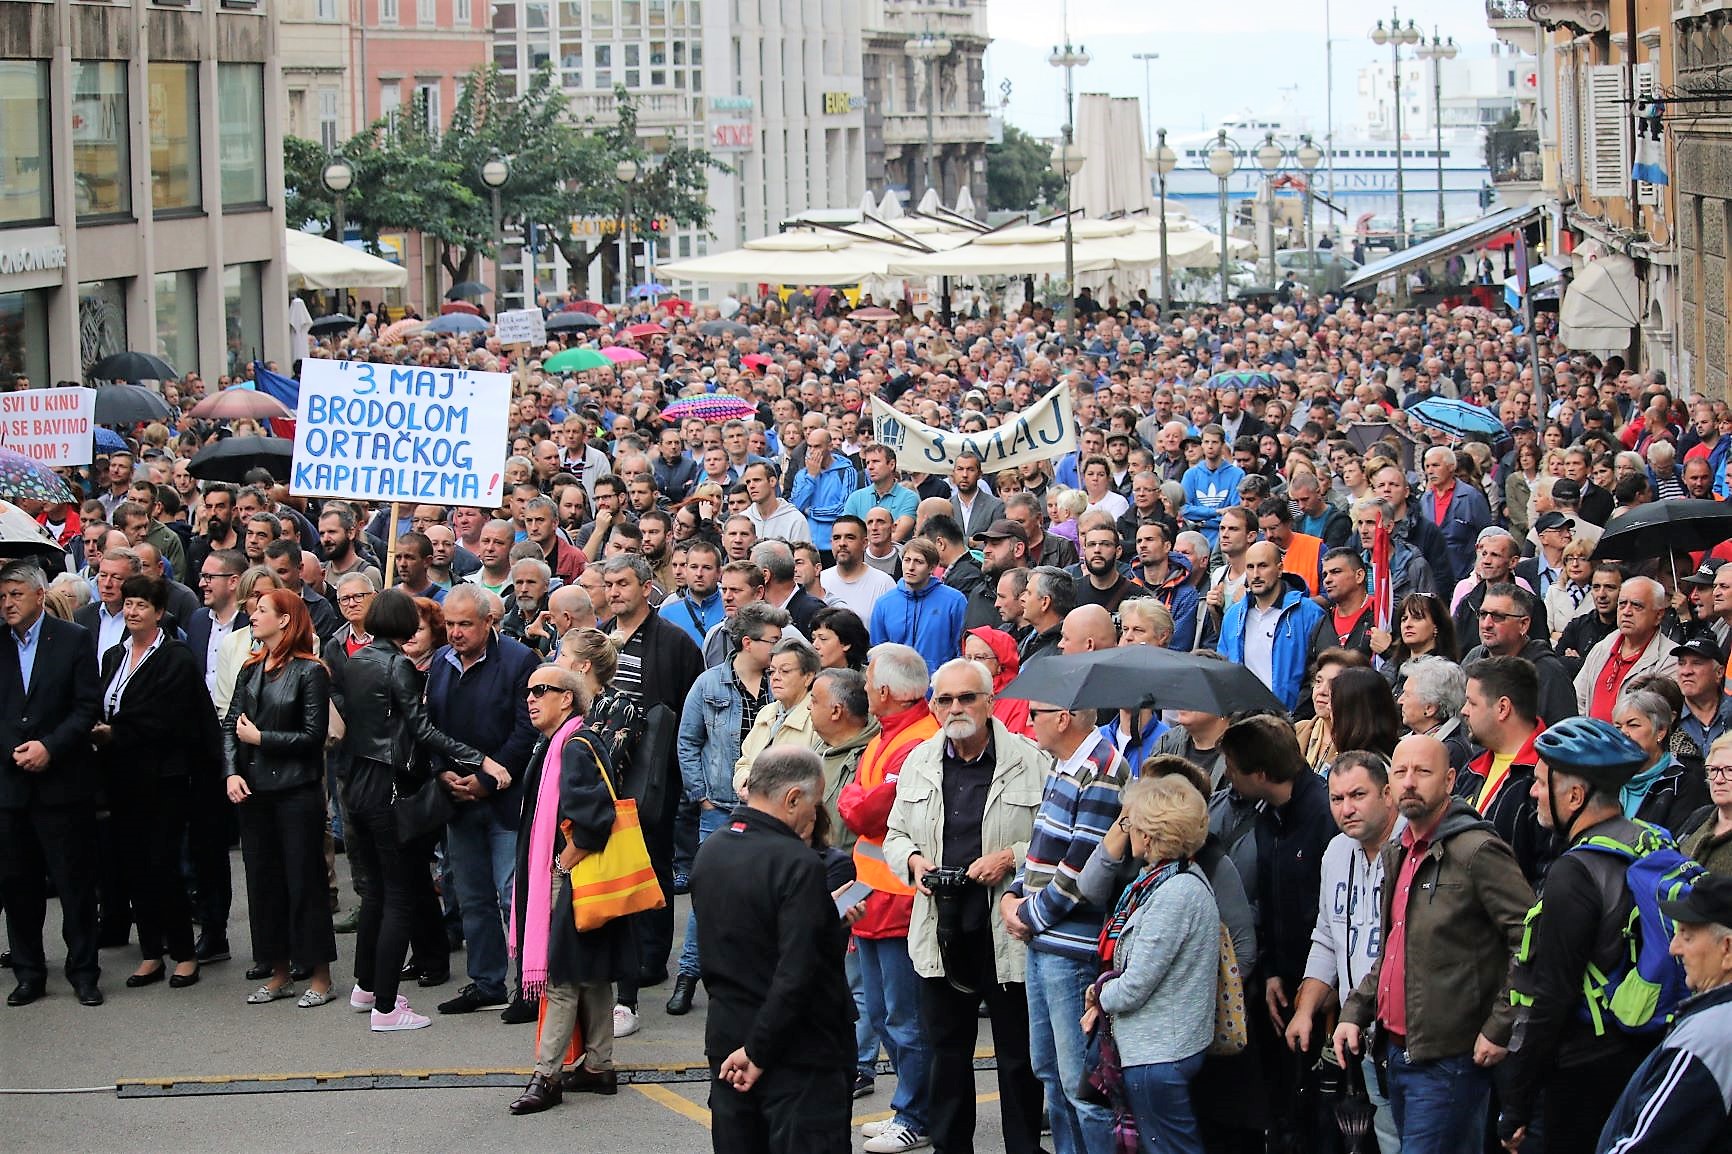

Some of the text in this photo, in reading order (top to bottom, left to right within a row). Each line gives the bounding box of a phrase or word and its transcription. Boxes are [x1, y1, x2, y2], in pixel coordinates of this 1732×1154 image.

[1245, 172, 1400, 189] JOINIJA
[2, 394, 79, 413] SVI U KINU
[307, 394, 469, 434] BRODOLOM
[0, 417, 88, 436] A SE BAVIMO
[305, 428, 473, 471] ORTAČKOG
[294, 462, 479, 499] KAPITALIZMA
